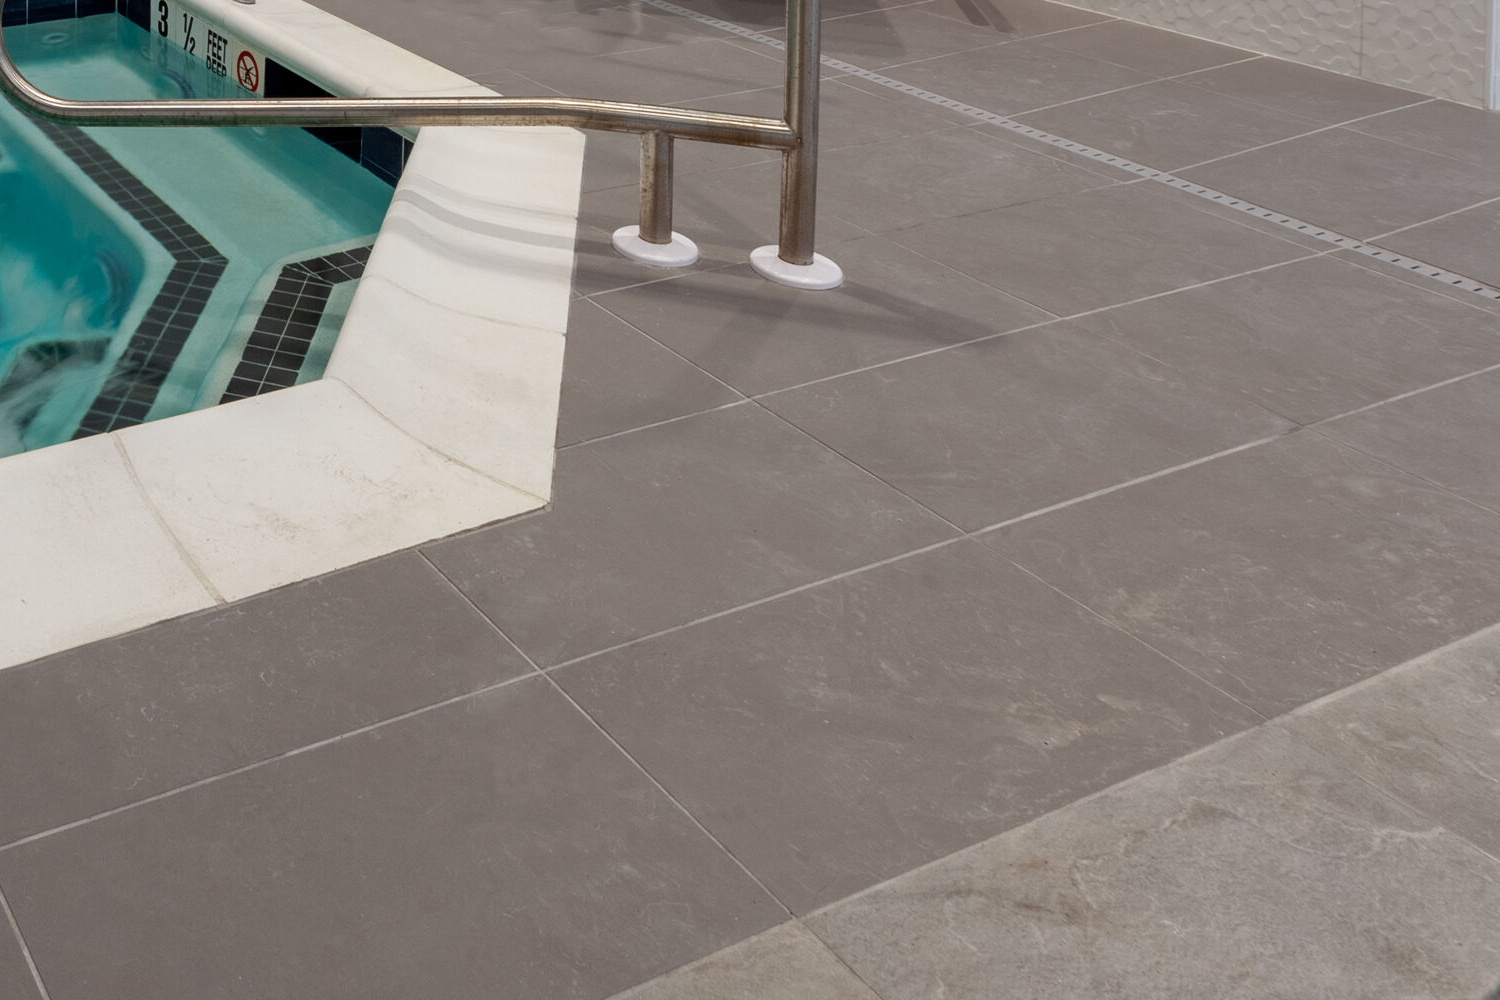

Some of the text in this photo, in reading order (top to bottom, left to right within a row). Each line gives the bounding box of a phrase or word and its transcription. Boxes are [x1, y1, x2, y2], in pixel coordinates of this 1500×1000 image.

[158, 0, 168, 37] 3
[207, 29, 228, 64] FEET
[206, 55, 226, 78] DEEP
